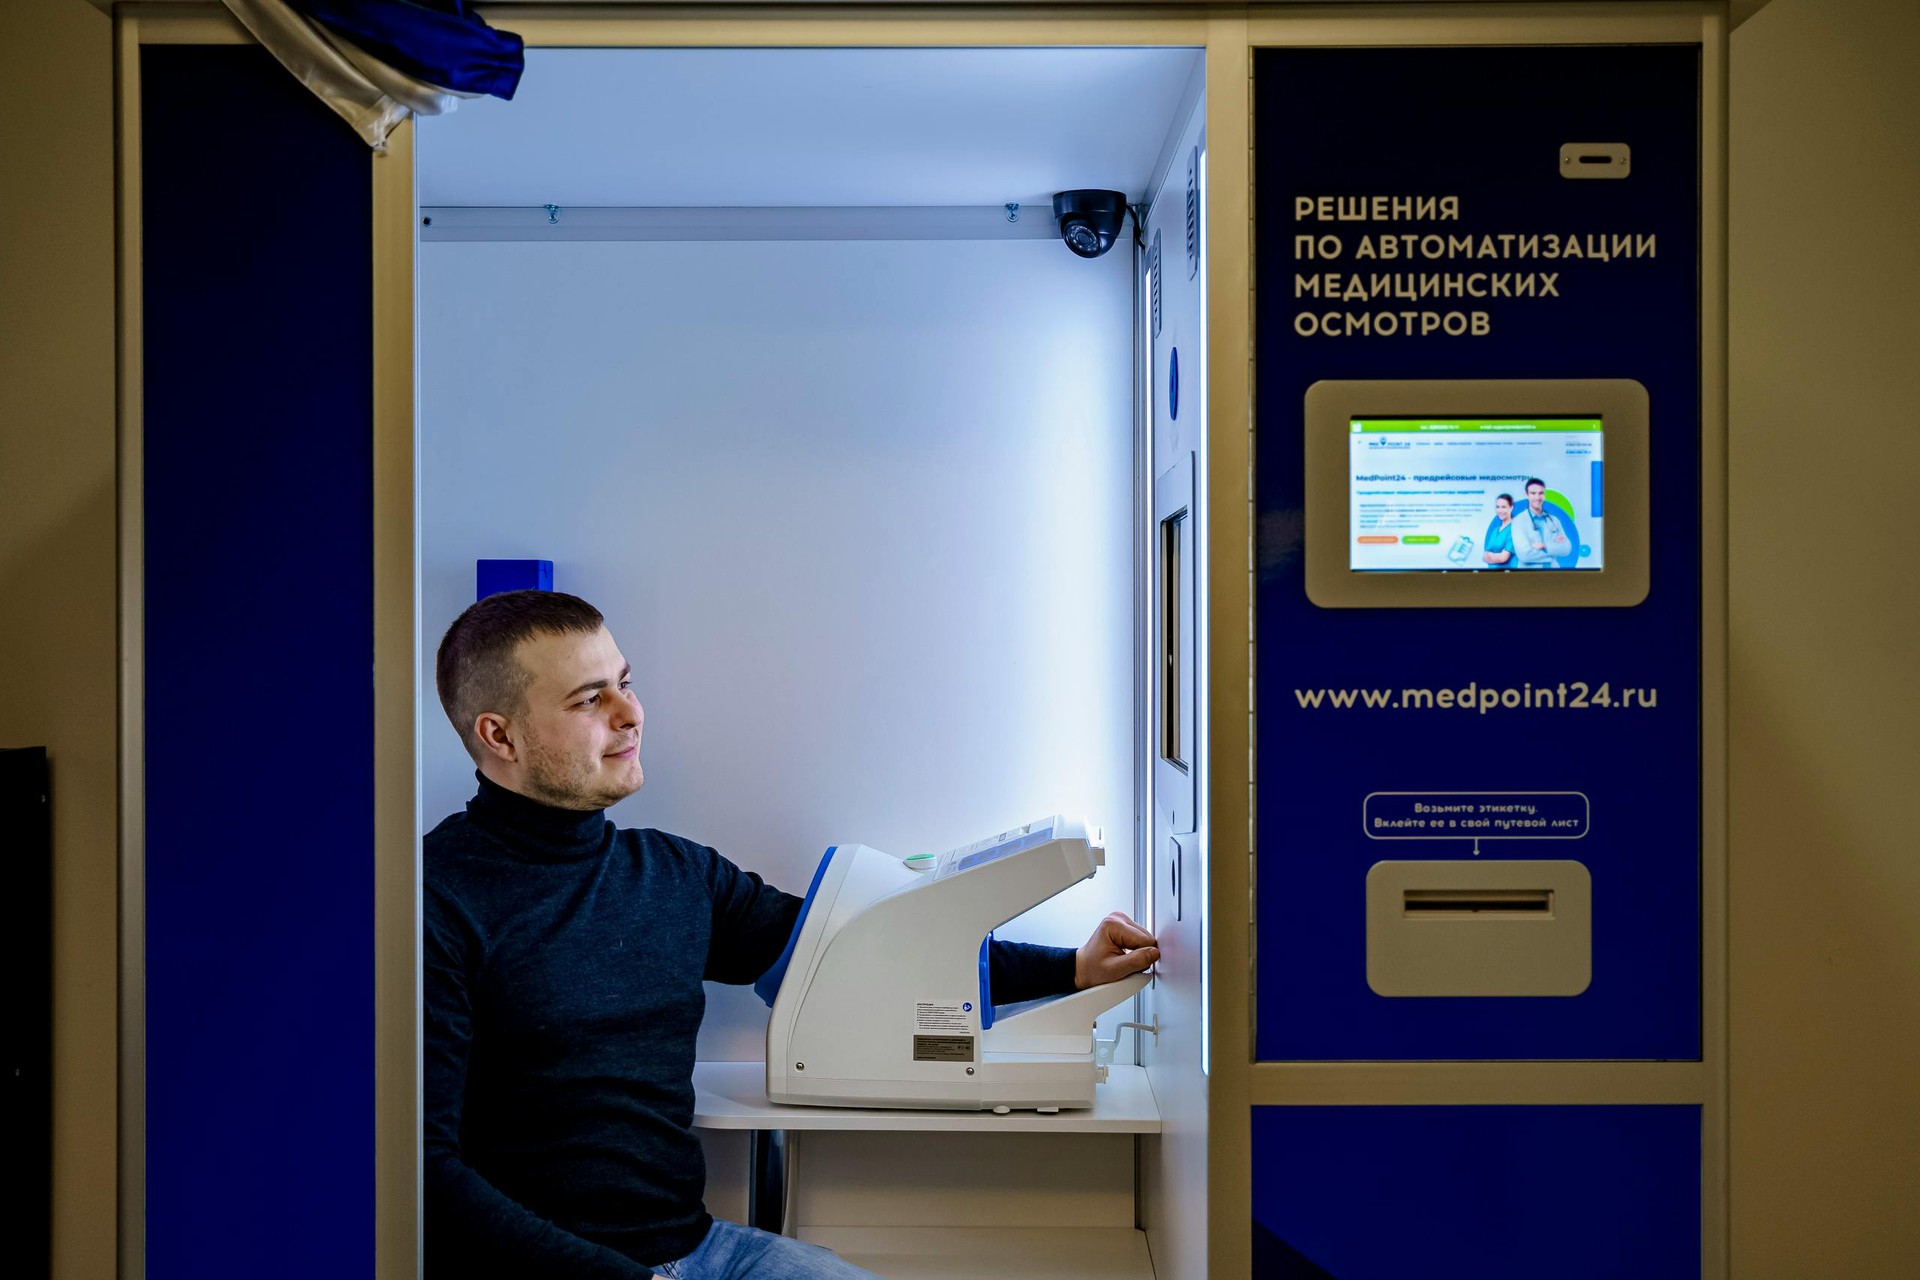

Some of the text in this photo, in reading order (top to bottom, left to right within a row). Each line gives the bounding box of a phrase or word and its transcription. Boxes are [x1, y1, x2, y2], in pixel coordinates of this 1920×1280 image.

[1295, 195, 1459, 221] РЕШЕНИЯ
[1295, 234, 1656, 262] ПО АВТОМАТИЗАЦИИ
[1295, 273, 1560, 301] МЕДИЦИНСКИХ
[1294, 311, 1491, 337] ОСМОТРОВ
[1356, 474, 1406, 482] MedPoint24
[1413, 474, 1477, 482] предрейсовые
[1295, 682, 1657, 714] www.medpoint24.ru
[1414, 802, 1475, 813] Возьмите
[1374, 817, 1579, 830] Вклейте ее в свой путевой лист
